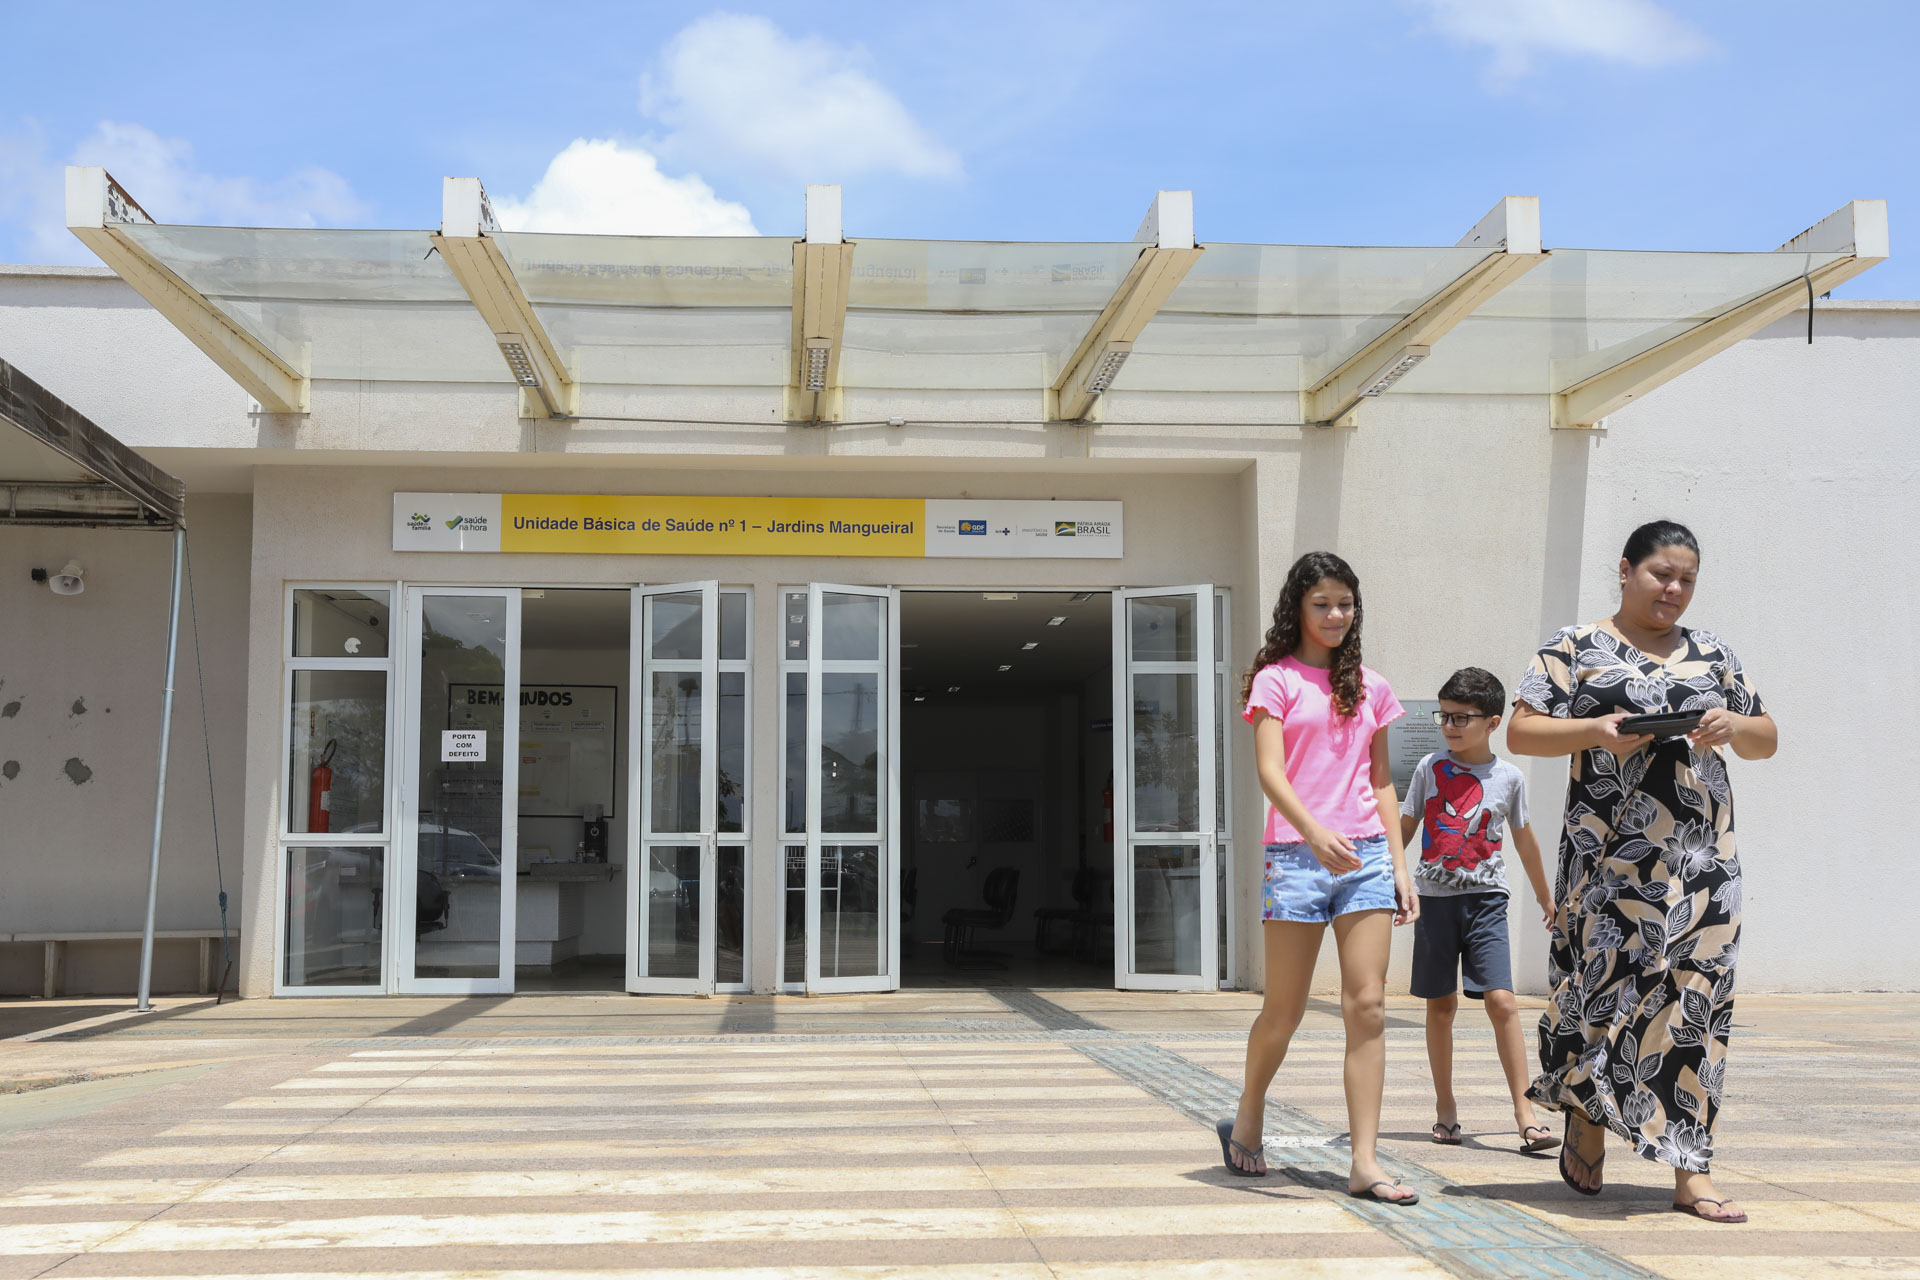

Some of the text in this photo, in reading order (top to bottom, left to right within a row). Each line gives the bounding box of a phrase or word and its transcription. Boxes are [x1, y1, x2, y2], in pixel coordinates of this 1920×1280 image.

[464, 516, 487, 524] saúde
[514, 517, 578, 530] Unidade
[583, 517, 635, 530] Básica
[642, 518, 661, 531] de
[665, 518, 714, 532] Saúde
[719, 519, 735, 532] nº
[740, 520, 746, 532] 1
[767, 520, 824, 533] Jardins
[829, 521, 913, 537] Mangueiral
[1077, 526, 1110, 534] BRASIL
[468, 689, 573, 706] BEM-INDOS
